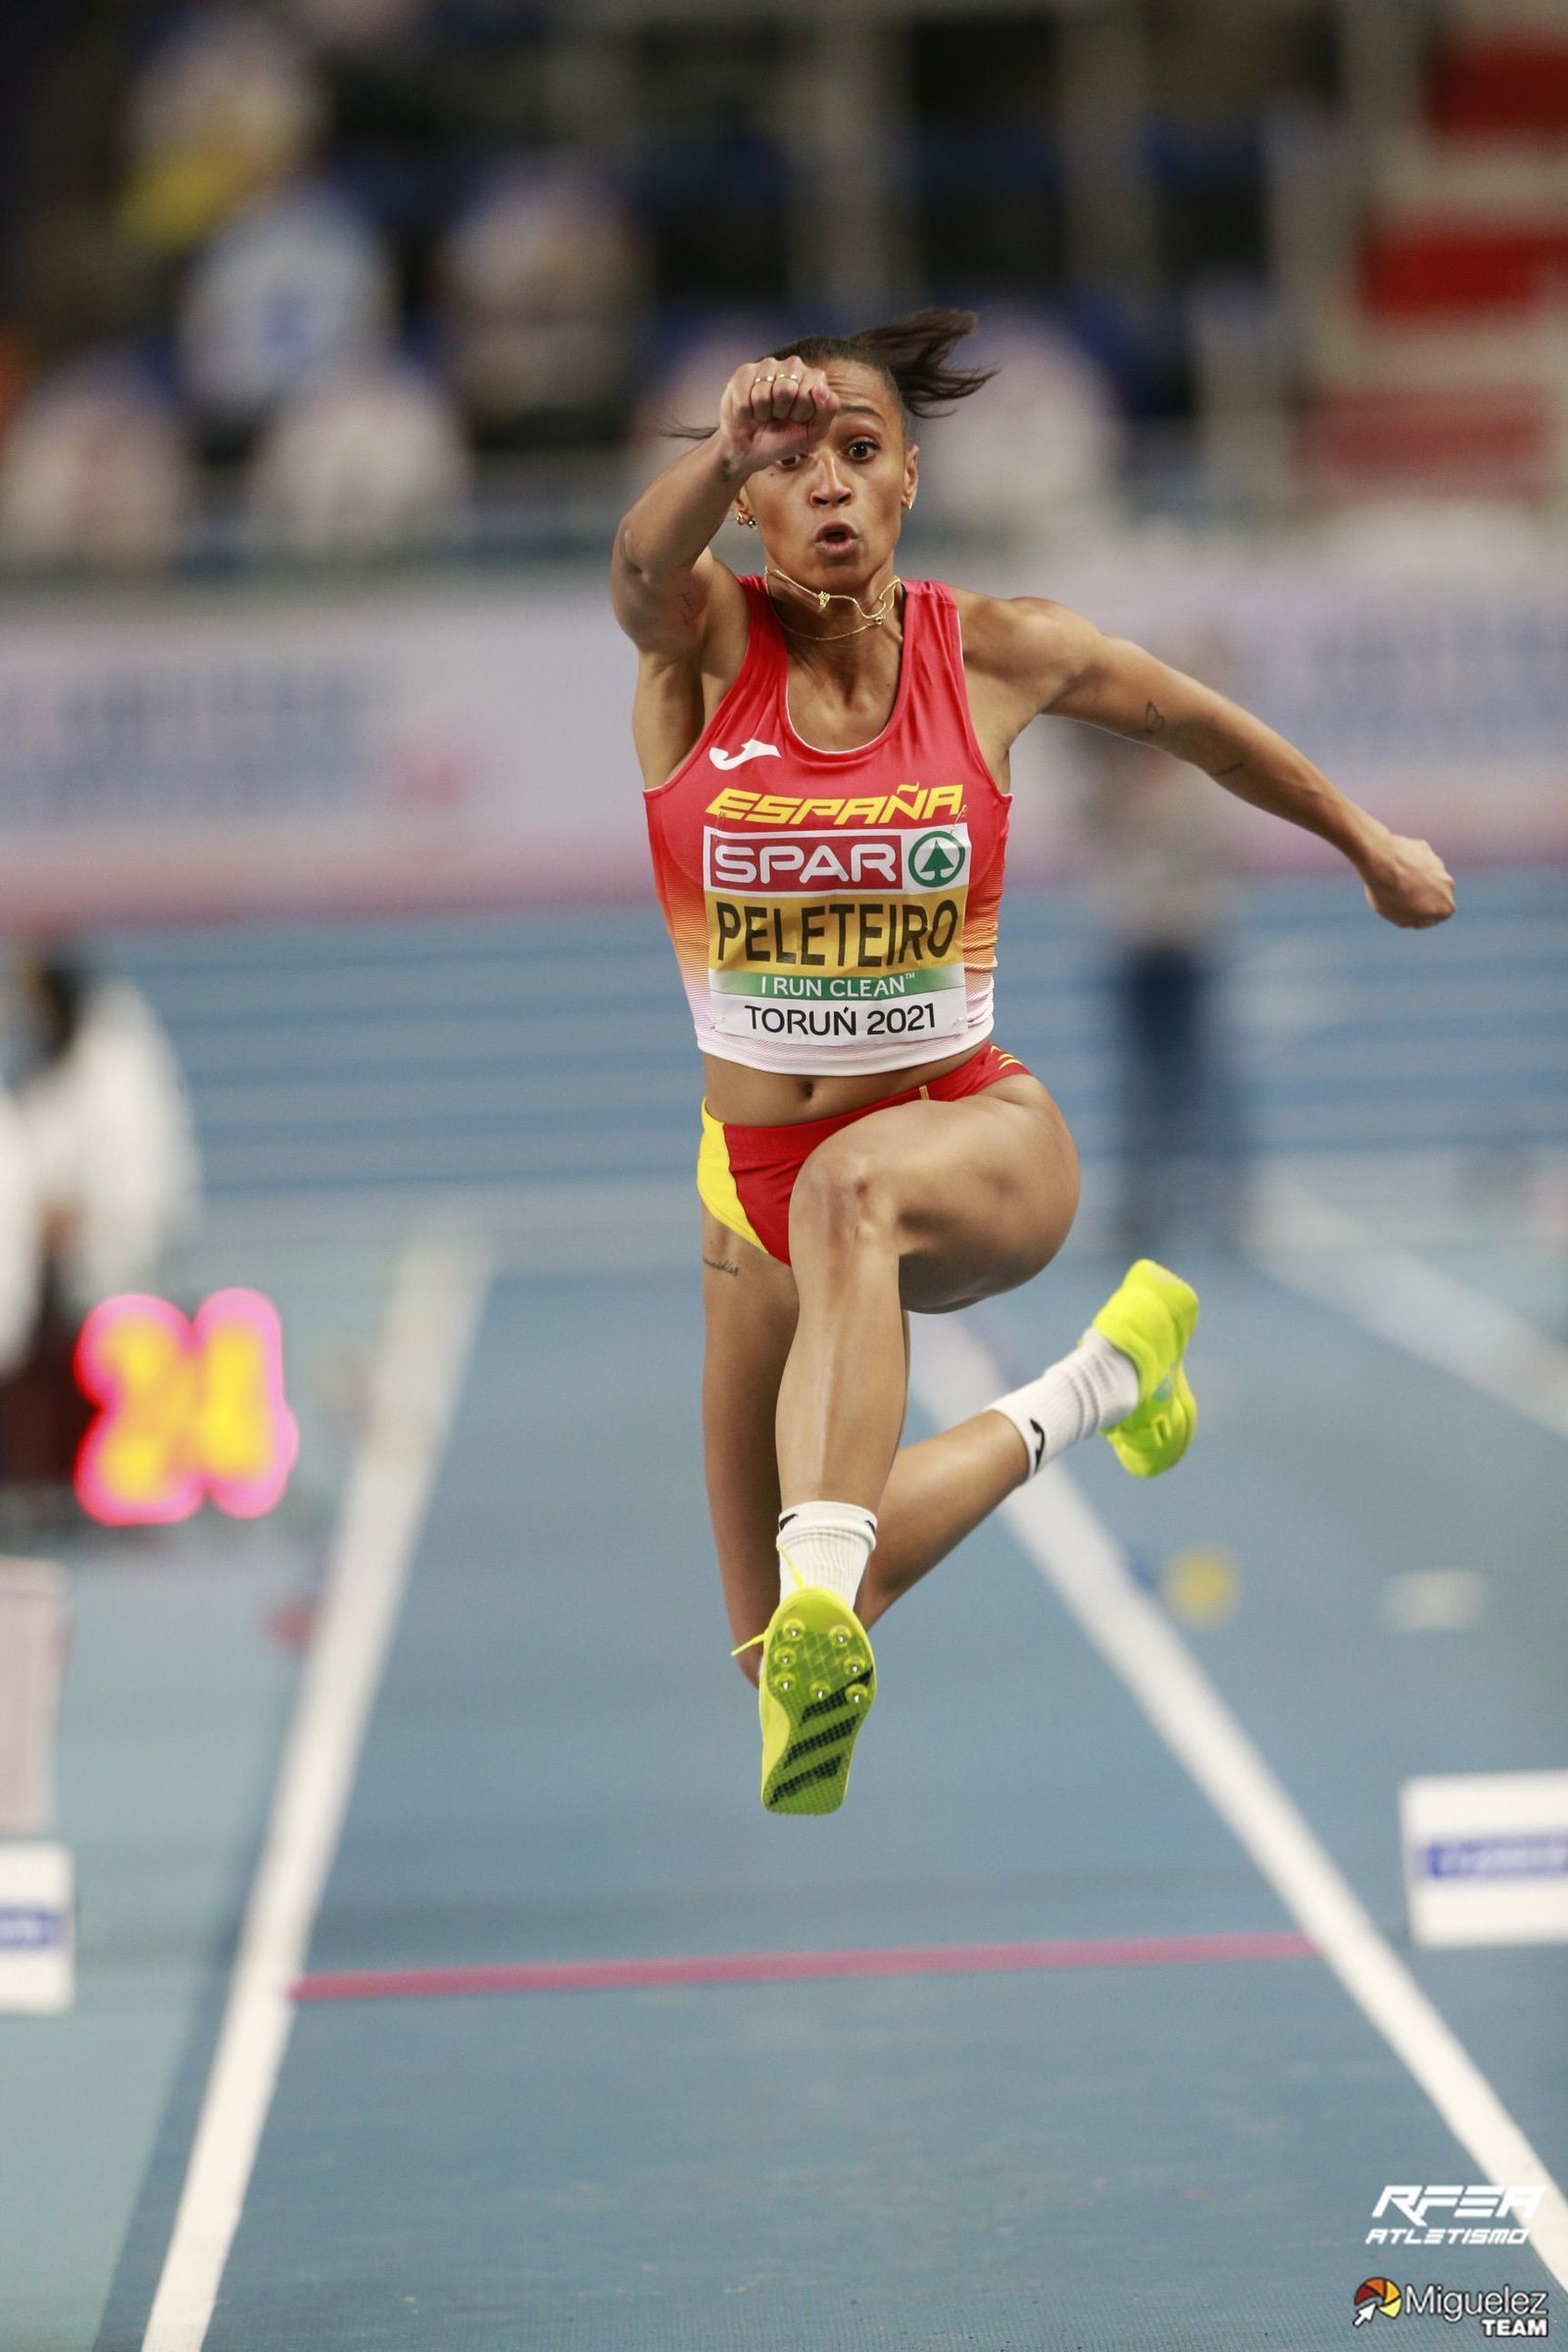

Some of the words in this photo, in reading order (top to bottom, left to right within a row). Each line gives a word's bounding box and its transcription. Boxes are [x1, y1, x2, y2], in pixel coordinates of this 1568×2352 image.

[706, 782, 963, 825] ESPAÑA
[714, 844, 897, 884] SPAR
[716, 900, 959, 967] PELETEIRO
[761, 977, 768, 995] I
[773, 977, 822, 998] RUN
[745, 1005, 857, 1036] TORUŃ
[866, 1003, 936, 1036] 2021
